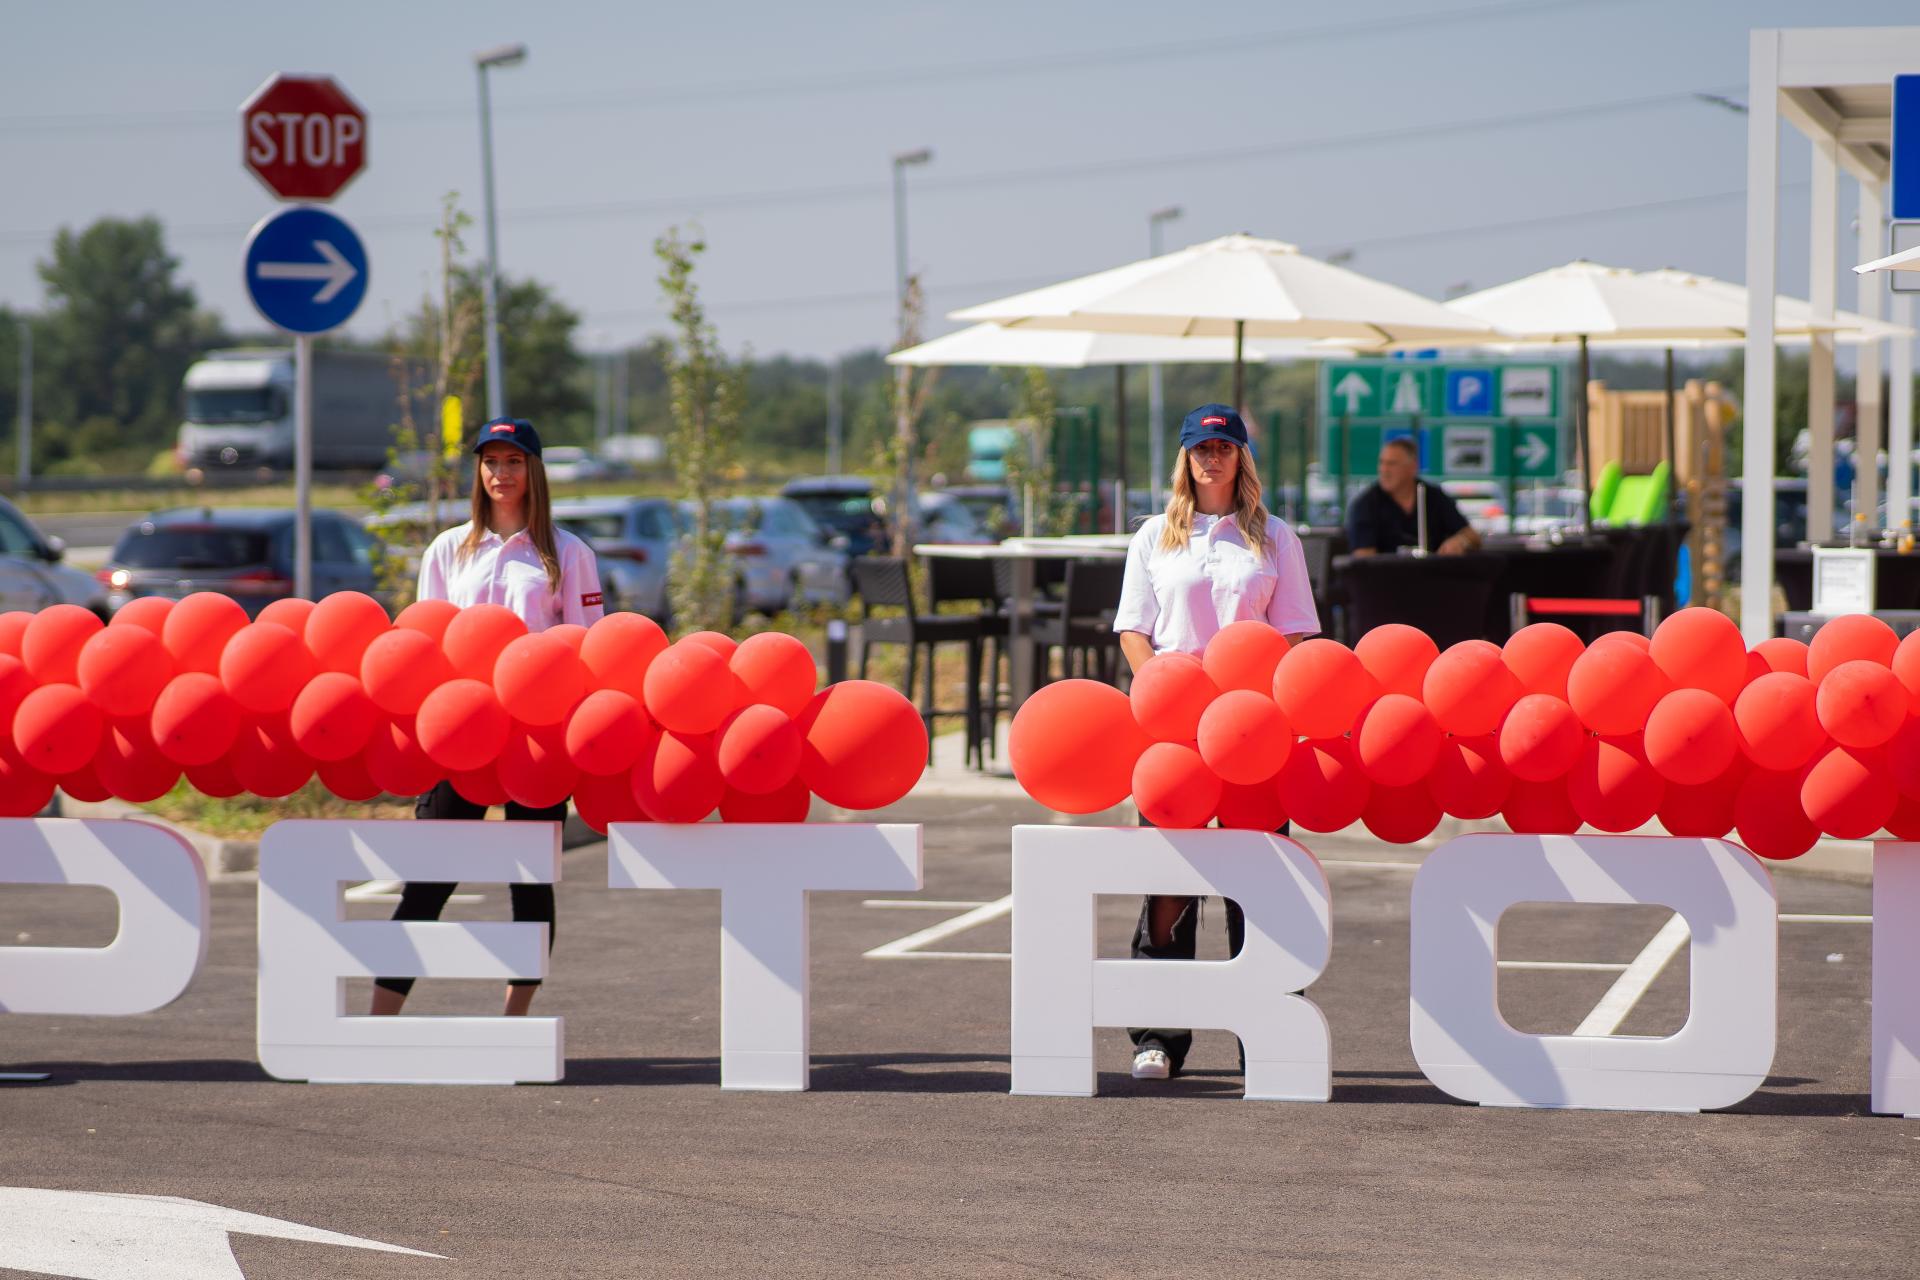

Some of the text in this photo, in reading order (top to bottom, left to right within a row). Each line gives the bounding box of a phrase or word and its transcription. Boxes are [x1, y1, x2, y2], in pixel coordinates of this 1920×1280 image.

[250, 111, 361, 166] STOP
[1457, 375, 1483, 407] P
[0, 817, 1920, 1118] PETRO
